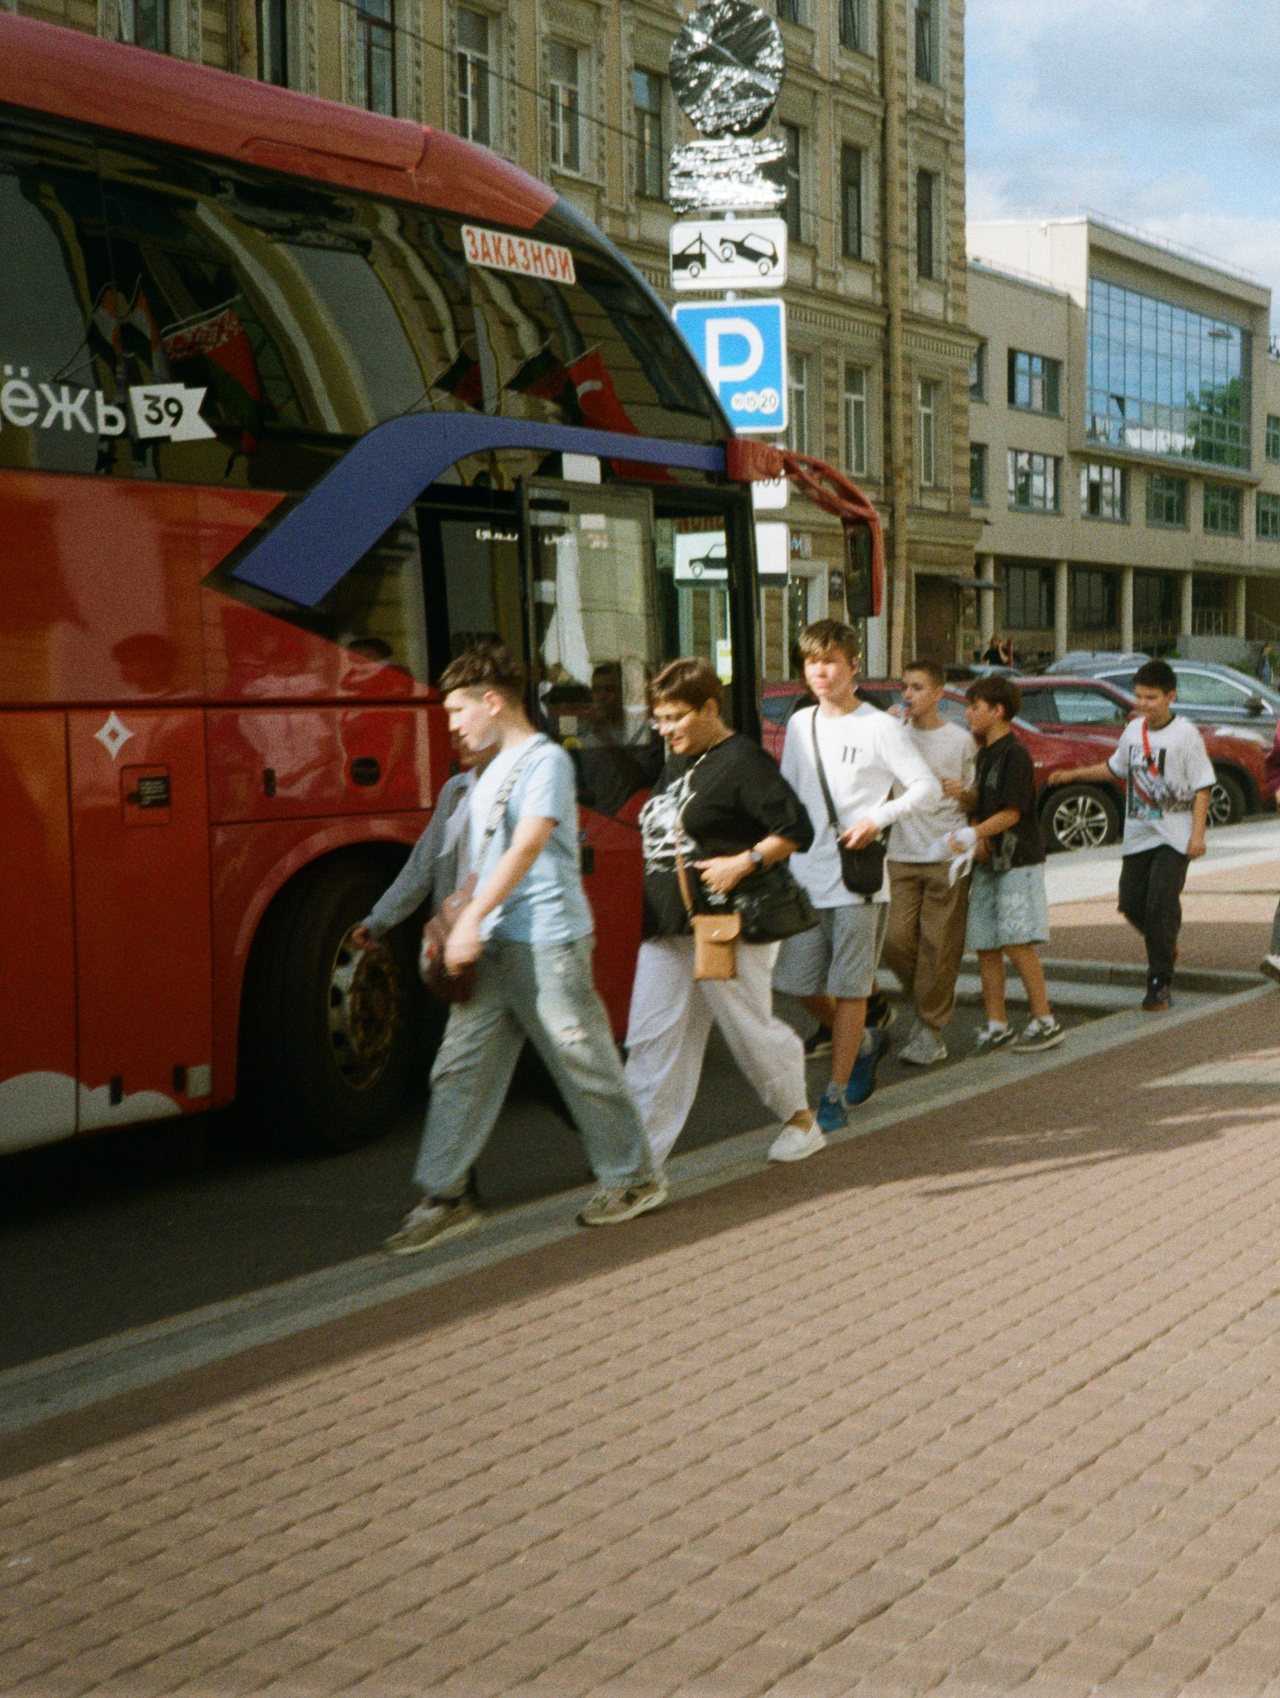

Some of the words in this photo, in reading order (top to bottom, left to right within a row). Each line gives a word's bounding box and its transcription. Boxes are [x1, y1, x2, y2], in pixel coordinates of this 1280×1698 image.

[0, 364, 127, 436] ёжь
[143, 393, 184, 428] 39
[761, 394, 777, 408] 20
